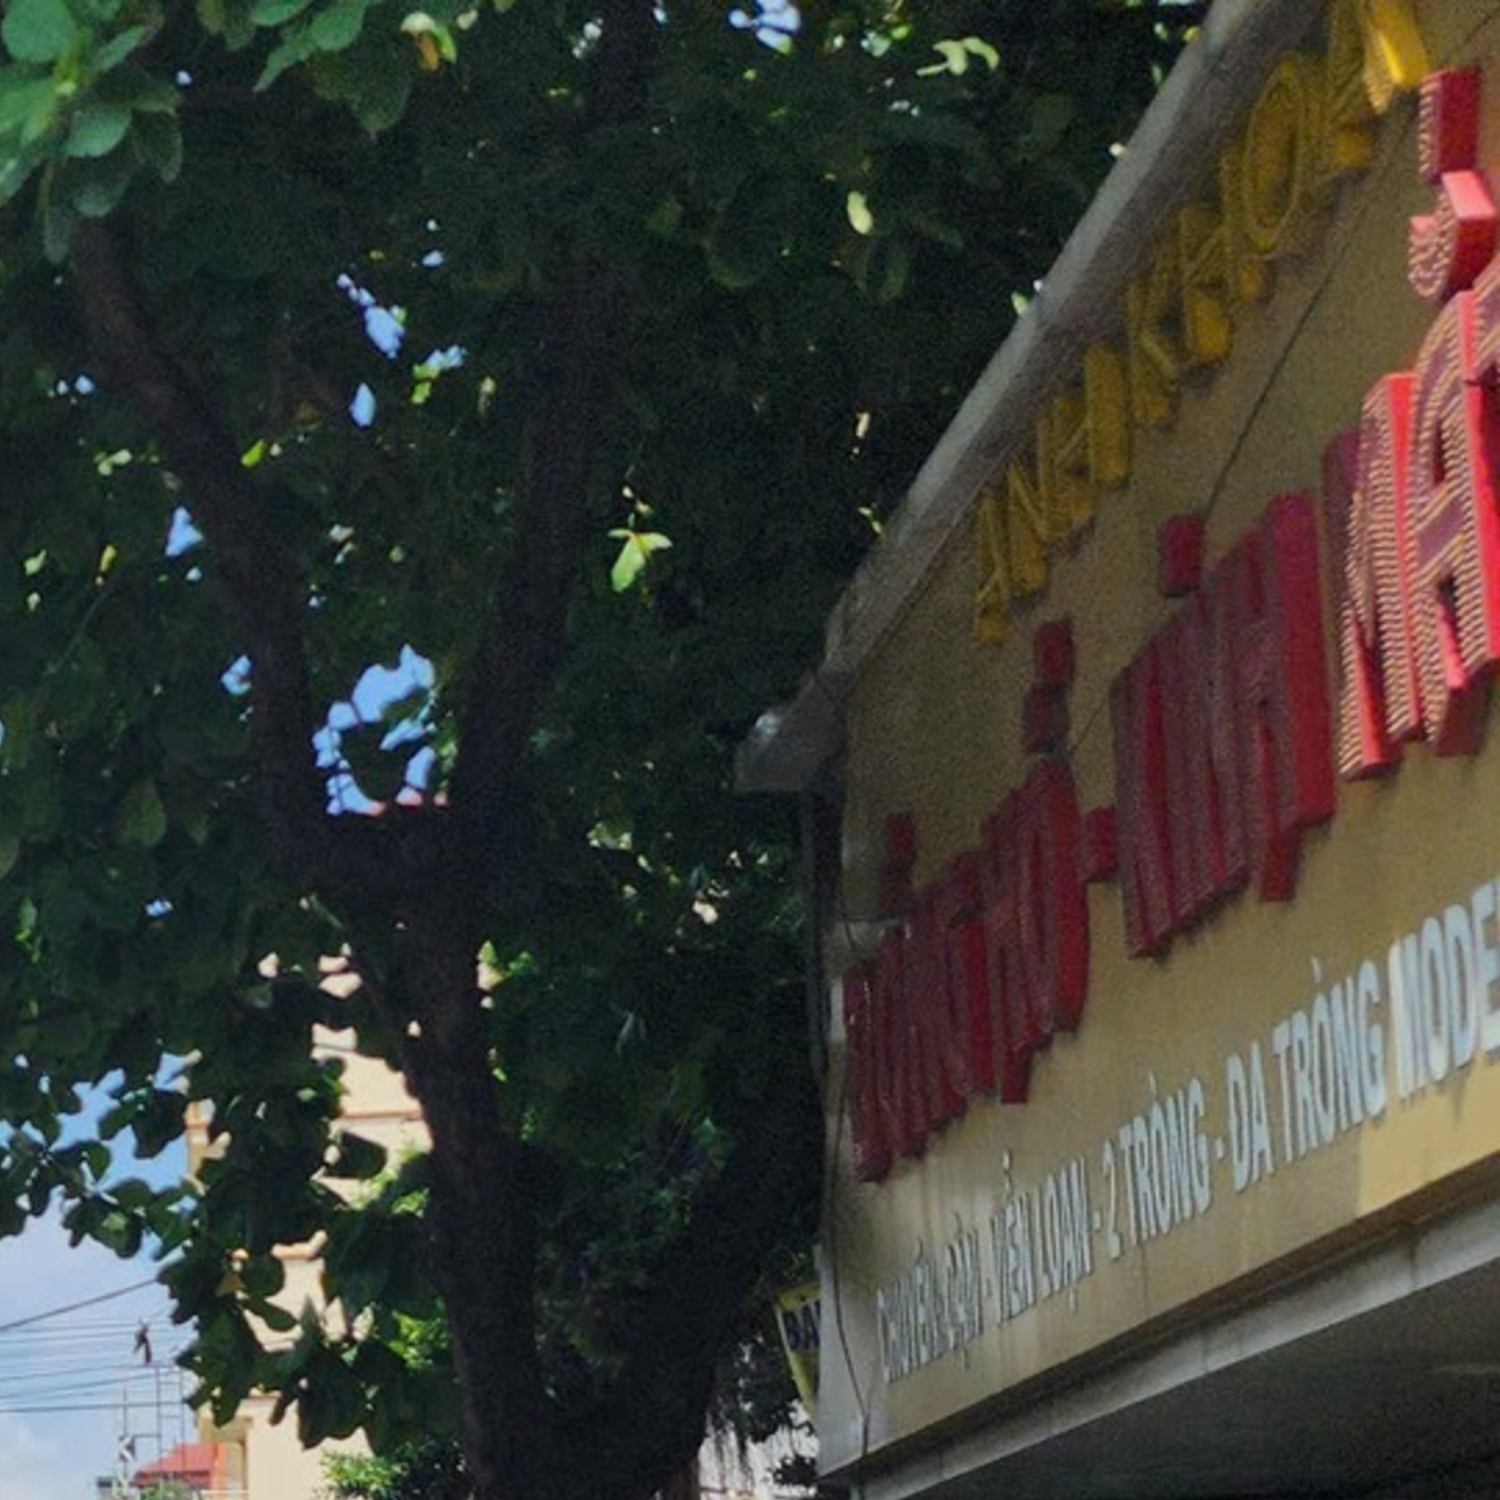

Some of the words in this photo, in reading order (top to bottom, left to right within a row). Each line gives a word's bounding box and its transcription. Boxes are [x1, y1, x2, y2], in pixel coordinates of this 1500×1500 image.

[1102, 1136, 1122, 1260] 2
[1118, 1070, 1211, 1248] TRÒNG
[1272, 955, 1388, 1164] TRÒNG
